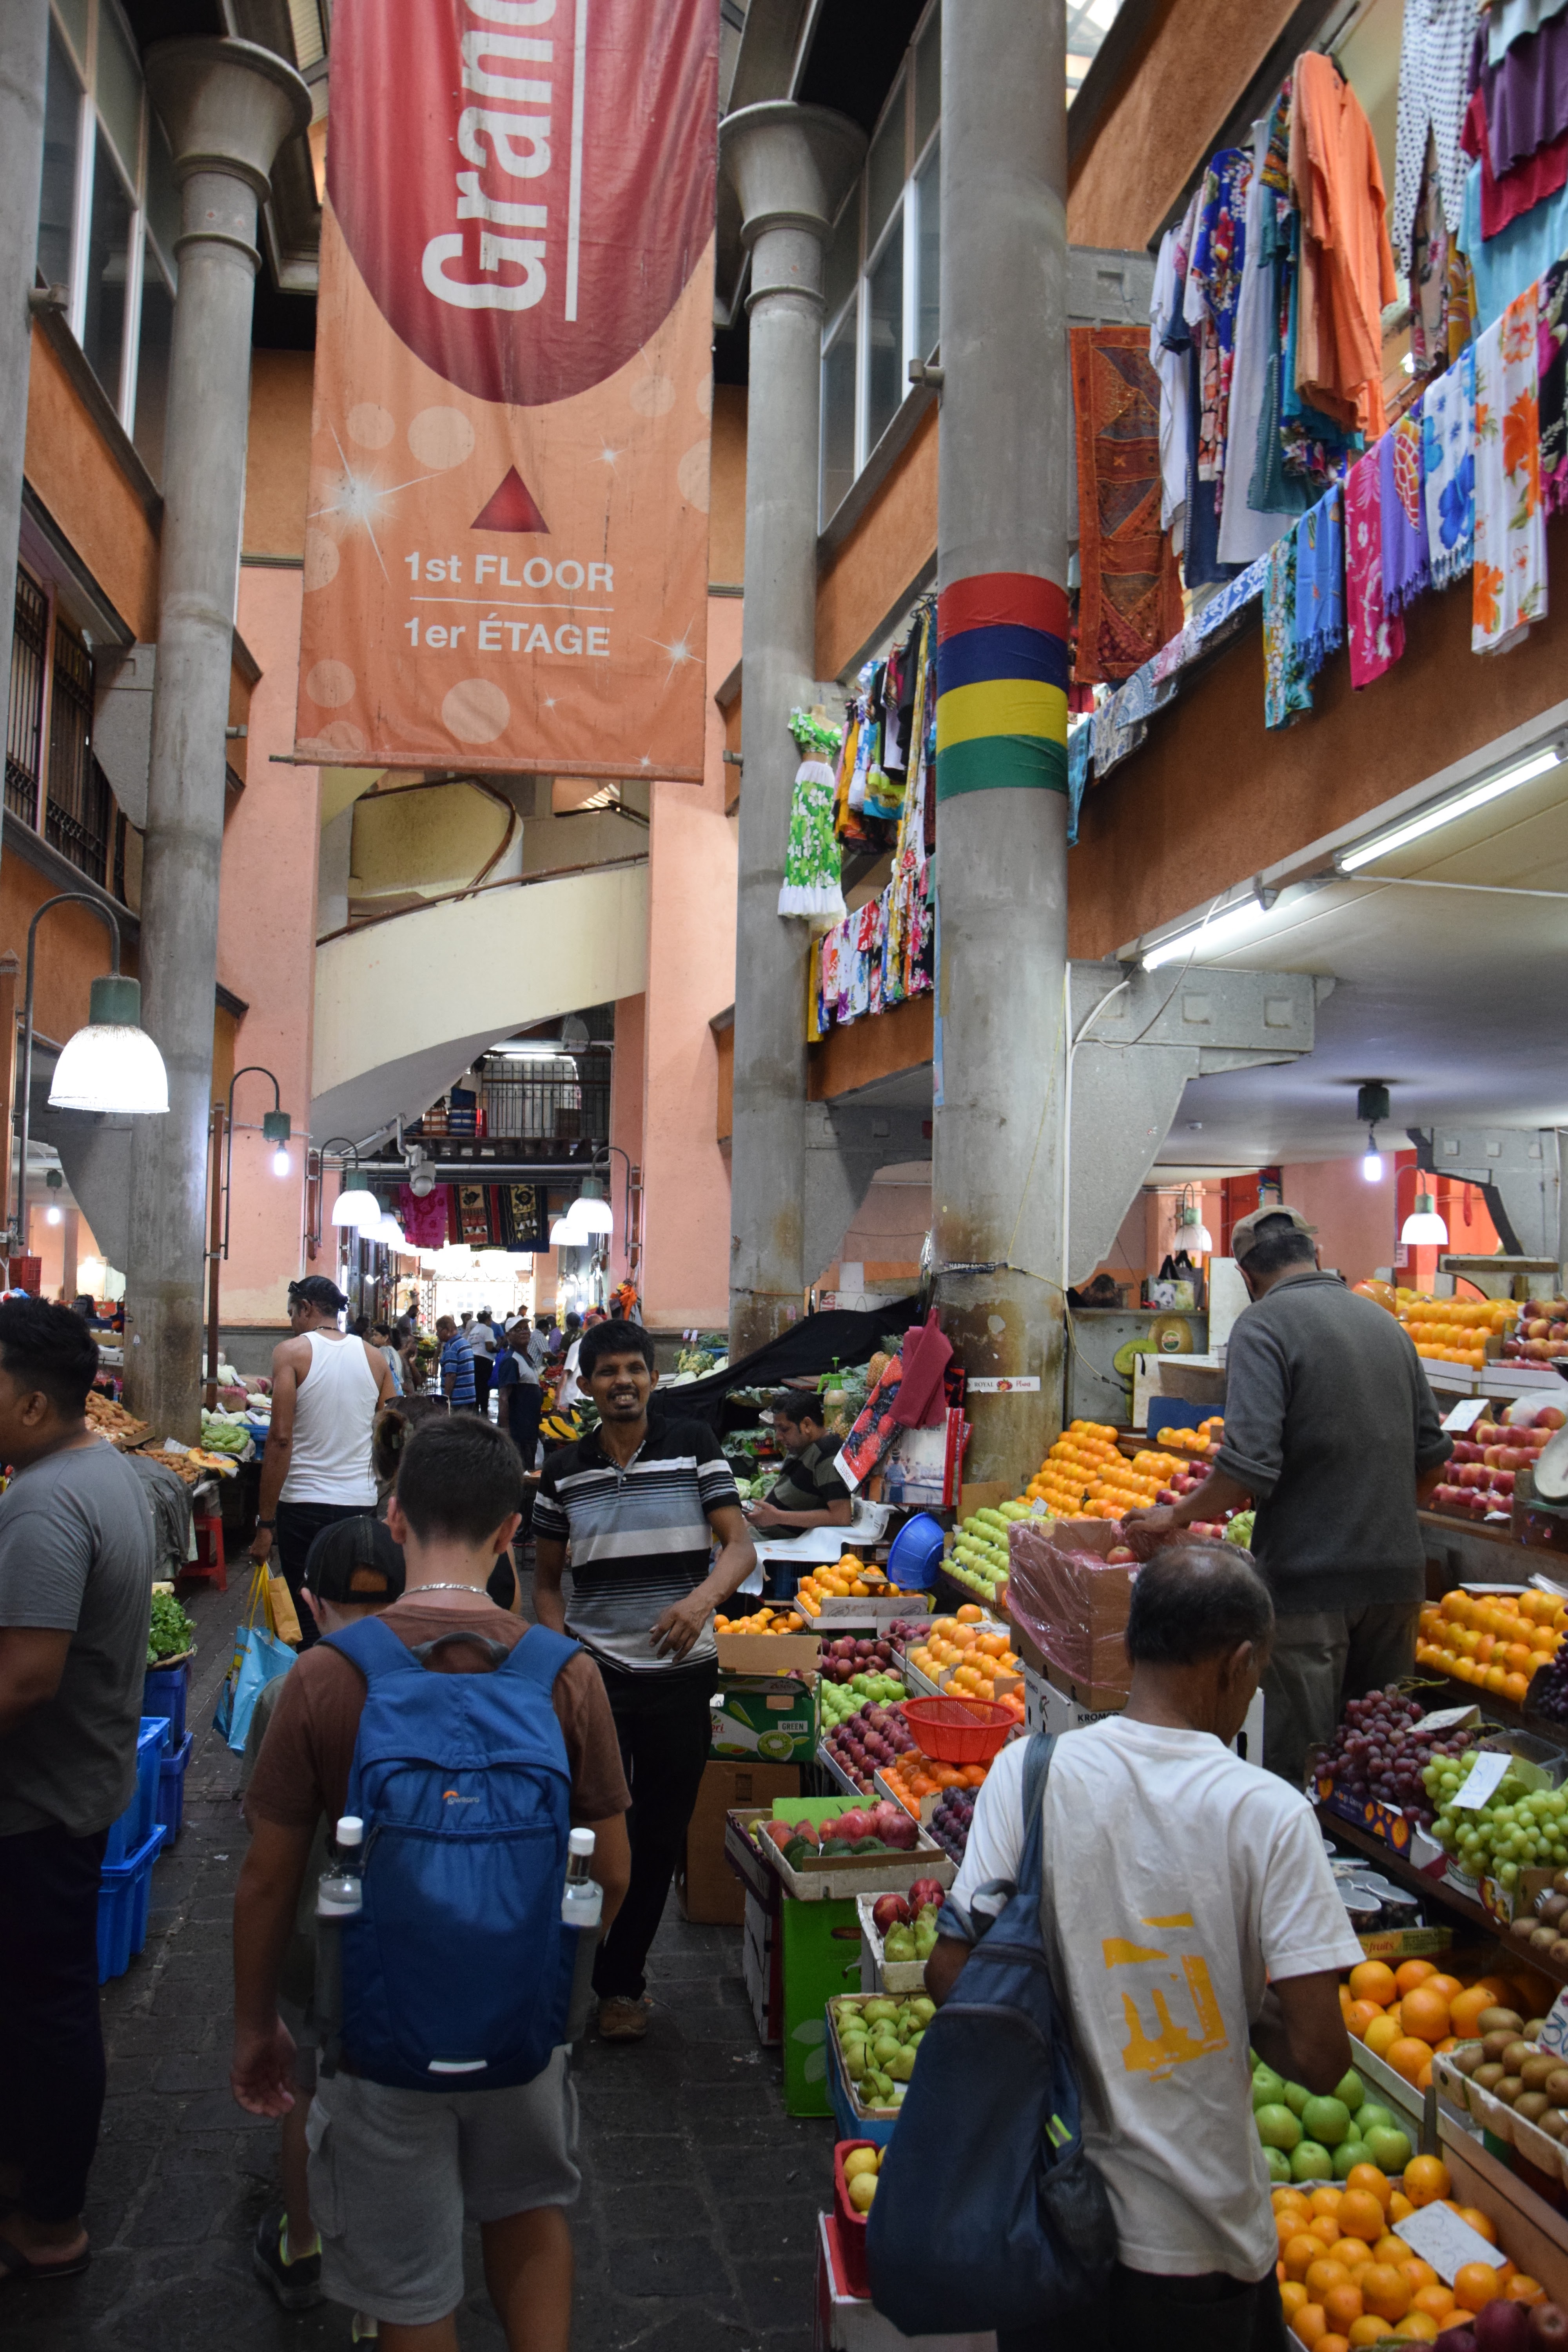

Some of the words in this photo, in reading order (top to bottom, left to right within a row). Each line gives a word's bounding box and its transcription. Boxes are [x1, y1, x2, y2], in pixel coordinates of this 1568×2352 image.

[404, 552, 462, 583] 1st
[475, 554, 614, 592] FLOOR
[404, 617, 466, 648] 1er
[478, 612, 610, 657] ÉTAGE
[1369, 1942, 1394, 1953] fruits
